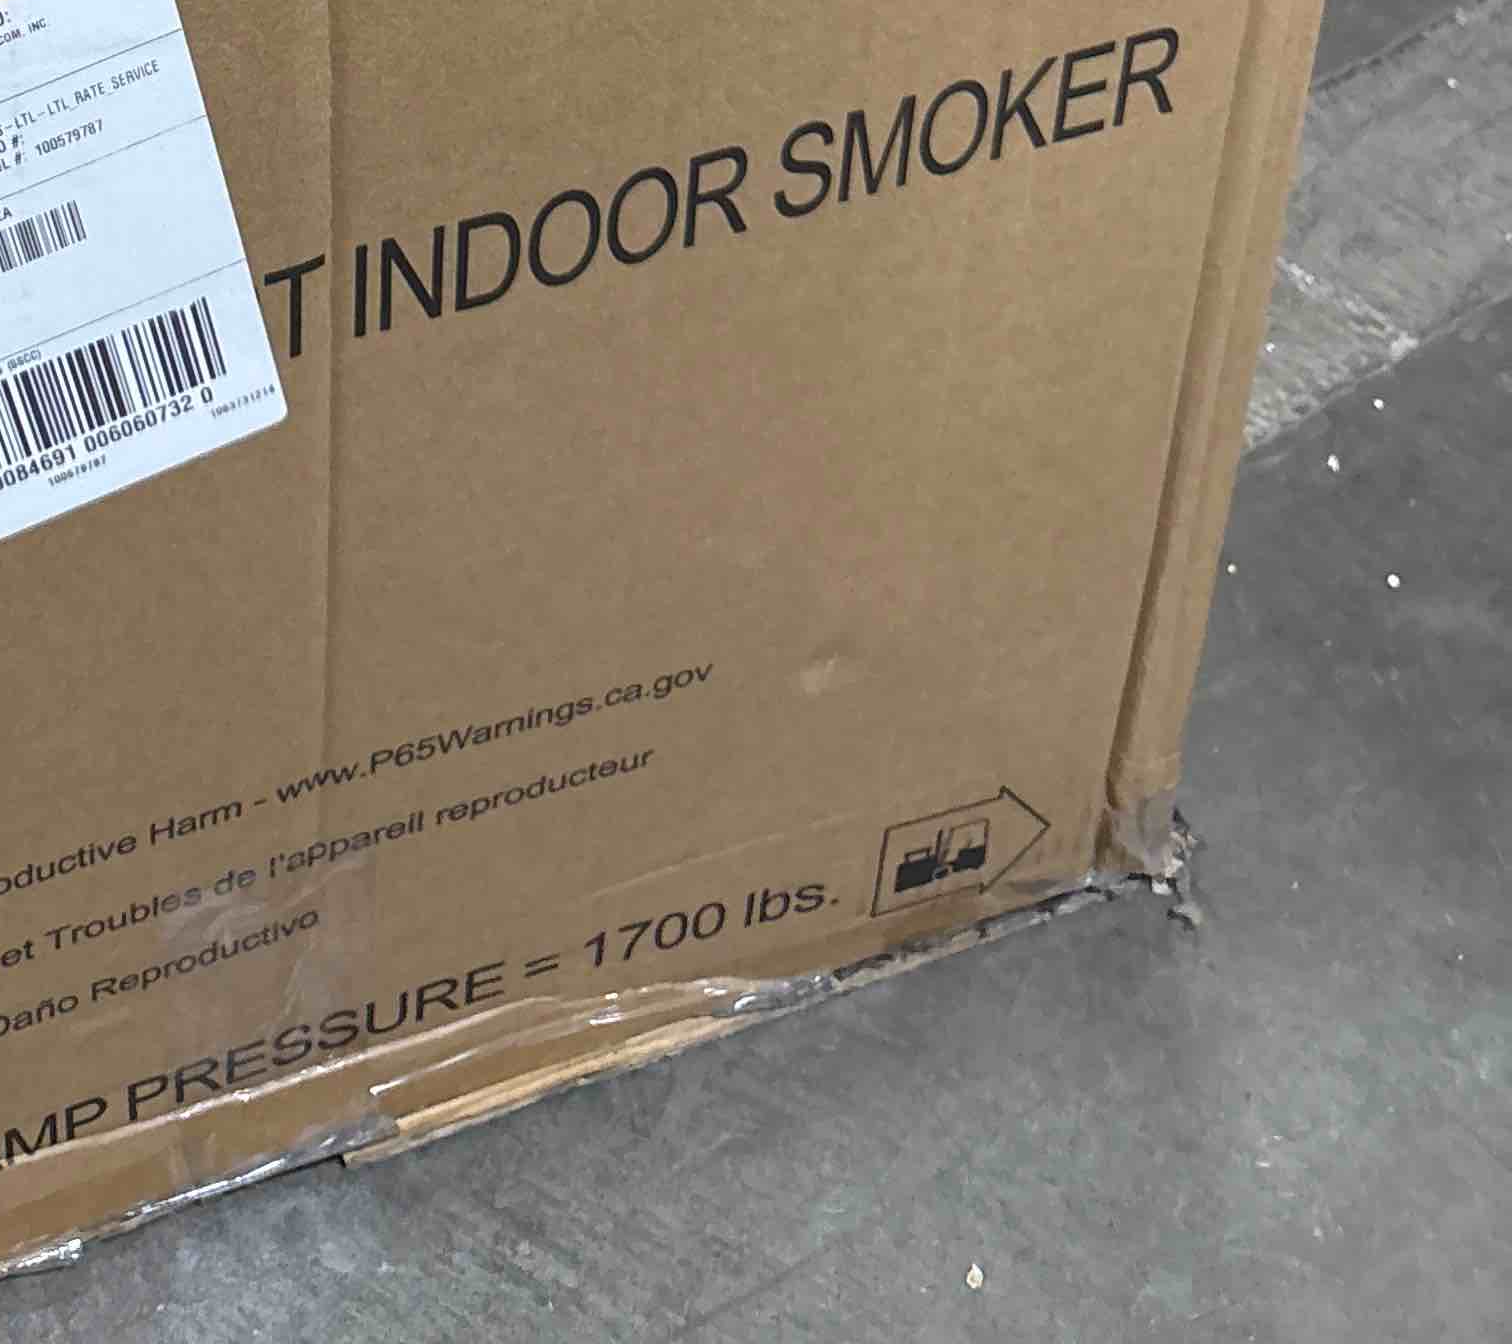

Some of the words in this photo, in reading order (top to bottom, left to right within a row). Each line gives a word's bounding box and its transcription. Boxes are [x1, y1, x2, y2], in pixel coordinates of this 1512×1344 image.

[34, 118, 104, 157] 100579787
[264, 253, 325, 358] T
[352, 144, 749, 338] INDOOR
[774, 27, 1179, 219] SMOKER
[83, 394, 195, 453] 006060732
[199, 386, 214, 404] 0
[149, 794, 243, 844] Harm
[275, 659, 714, 806] www.P65Warnings.ca.gov
[1, 936, 36, 969] et
[45, 883, 203, 954] Troubles
[212, 864, 258, 900] de
[266, 801, 425, 886] l'appareil
[434, 745, 656, 842] reproducteur
[90, 906, 321, 1005] Reproductivo
[126, 958, 506, 1124] PRESSURE
[525, 952, 561, 979] =
[585, 899, 729, 970] 1700
[742, 874, 842, 929] lbs.
